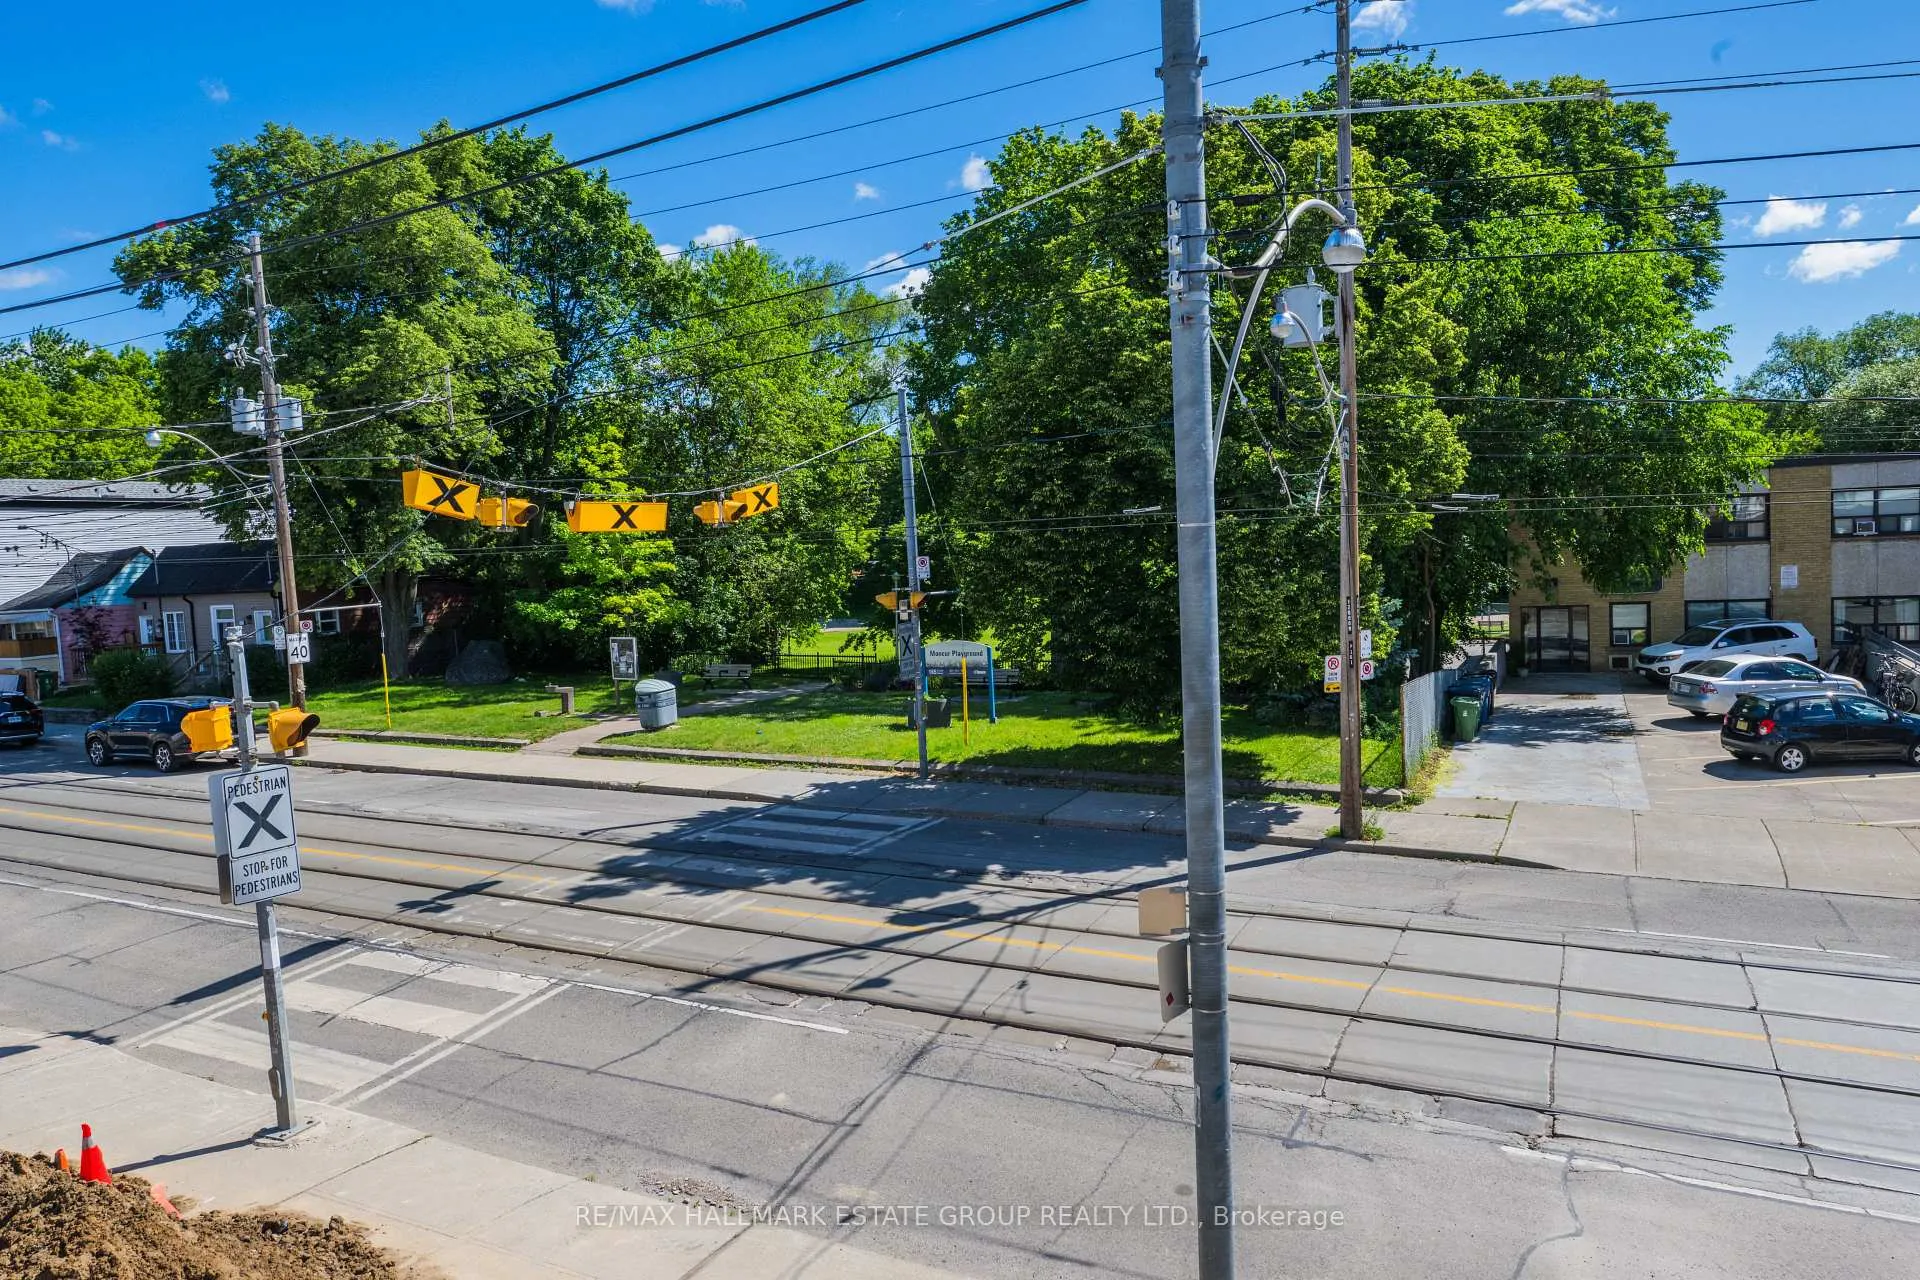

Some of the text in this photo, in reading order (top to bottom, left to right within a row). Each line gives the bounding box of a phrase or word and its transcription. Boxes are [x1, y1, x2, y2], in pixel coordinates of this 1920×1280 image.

[431, 476, 471, 513] X
[753, 487, 772, 512] X
[611, 504, 639, 529] X
[291, 645, 308, 659] 40
[901, 634, 913, 657] X
[951, 650, 984, 658] Playground
[228, 776, 287, 799] PEDESTRIAN
[233, 793, 288, 850] X
[243, 855, 288, 878] STOP FOR
[234, 871, 299, 897] PEDESTRIANS
